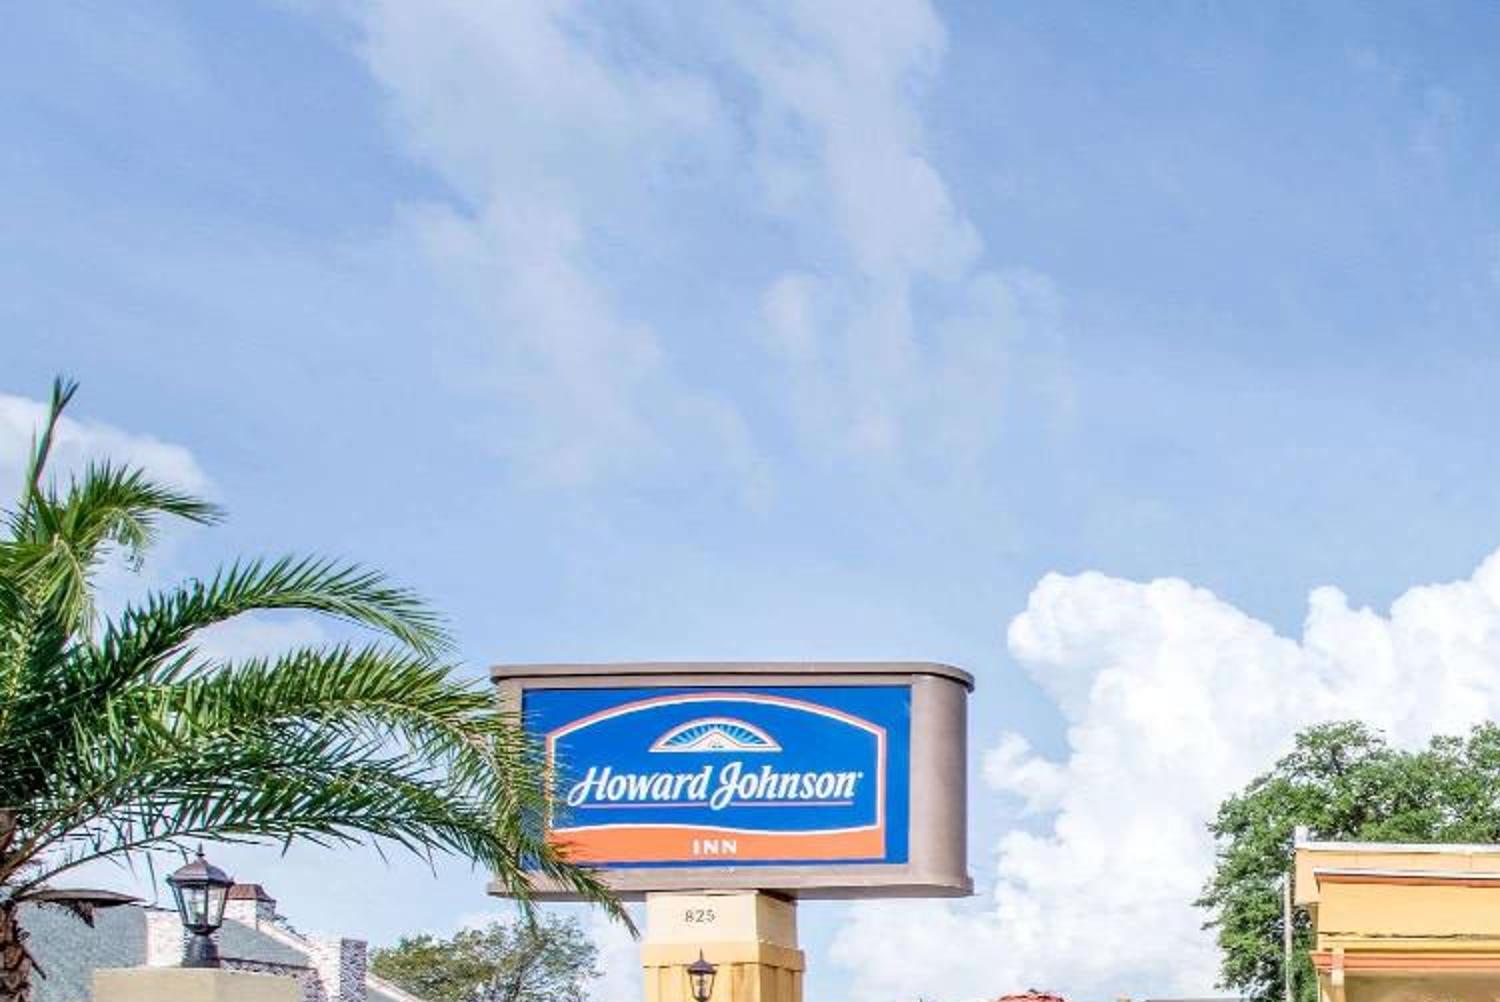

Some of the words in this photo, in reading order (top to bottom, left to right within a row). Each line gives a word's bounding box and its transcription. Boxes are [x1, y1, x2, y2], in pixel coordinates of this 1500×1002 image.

[567, 766, 714, 806] Howard
[710, 761, 856, 811] Johnson
[692, 840, 738, 855] INN
[685, 908, 716, 923] 825
